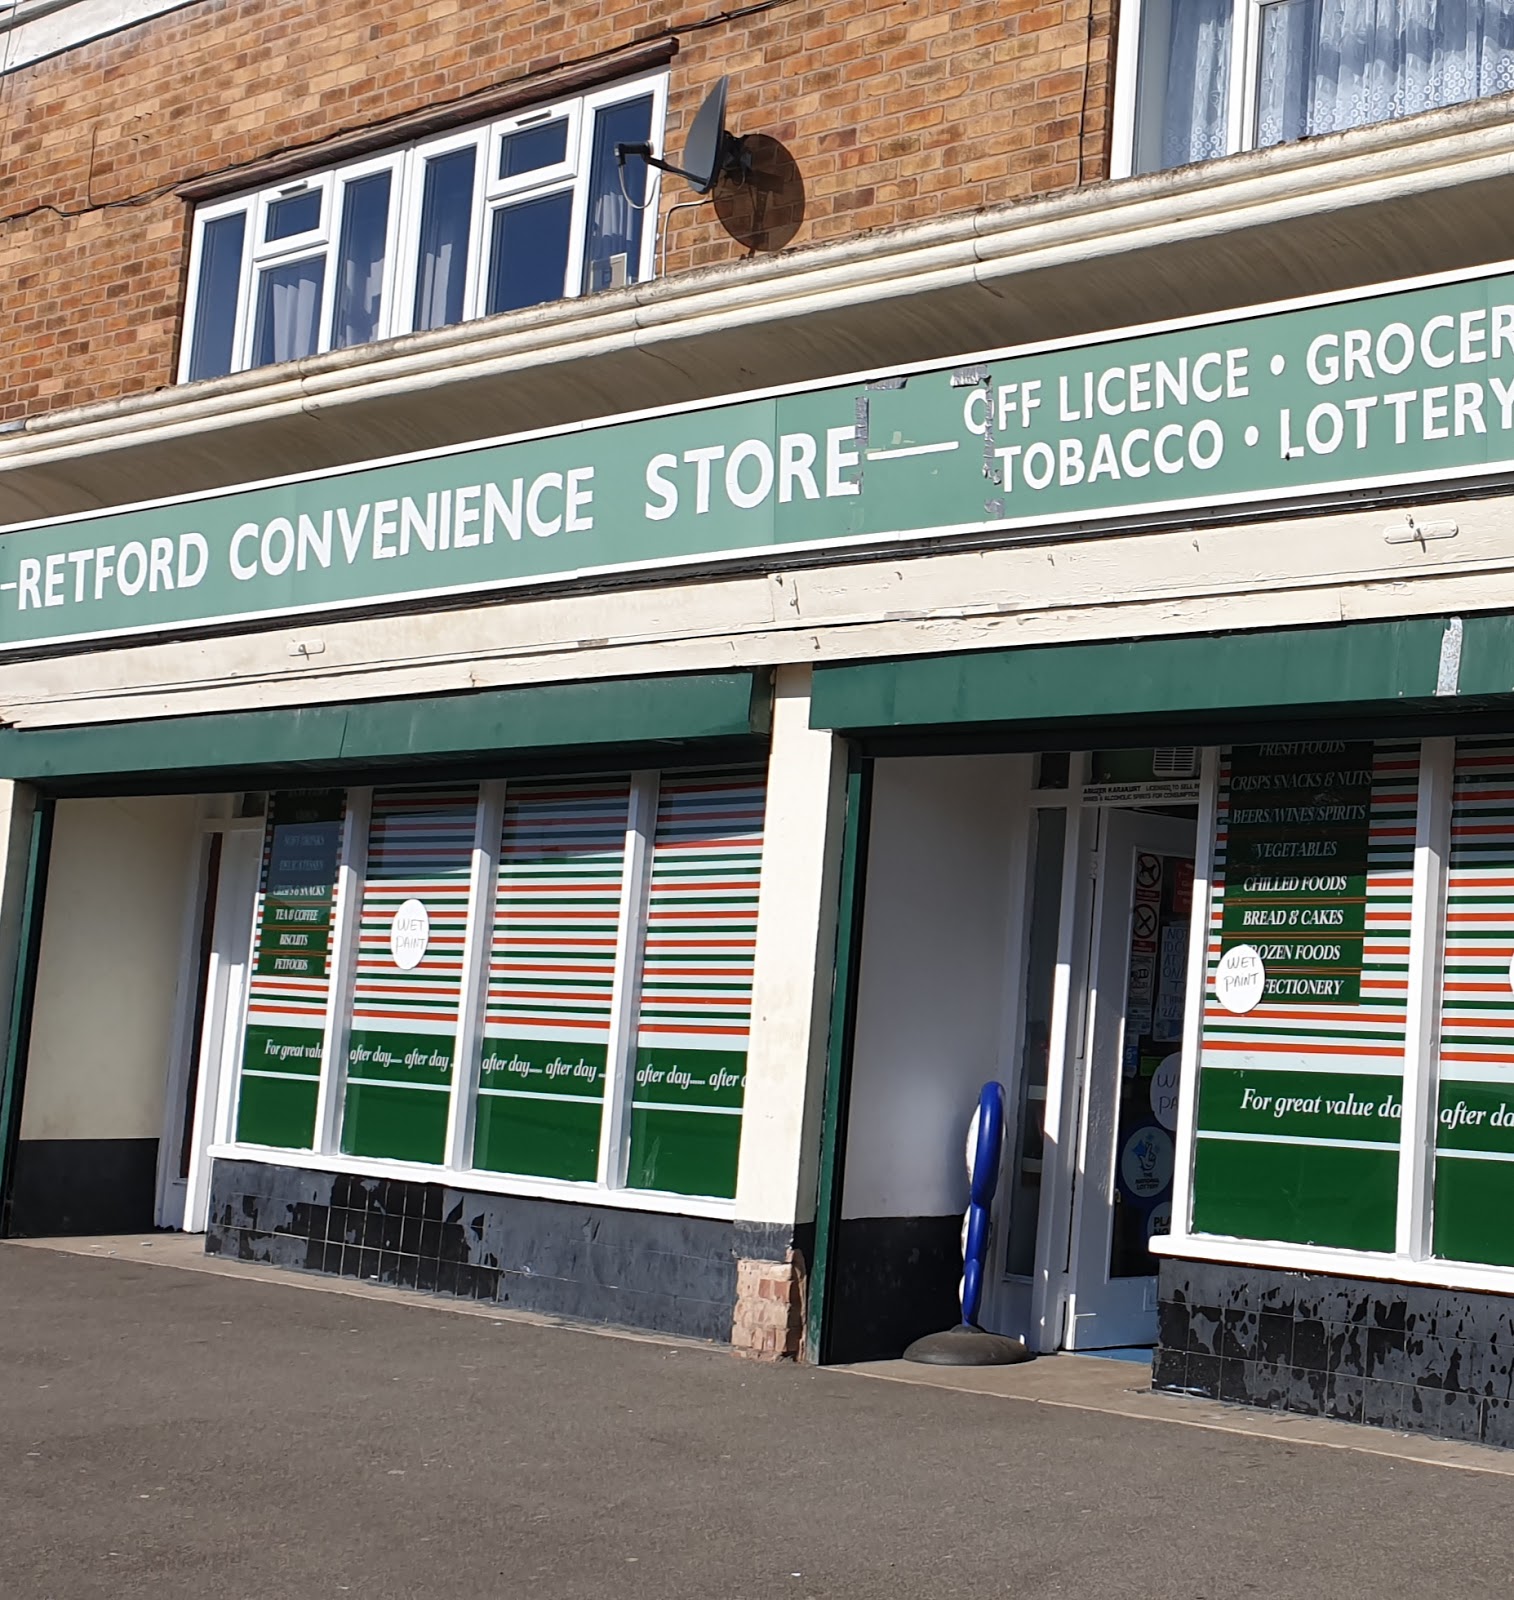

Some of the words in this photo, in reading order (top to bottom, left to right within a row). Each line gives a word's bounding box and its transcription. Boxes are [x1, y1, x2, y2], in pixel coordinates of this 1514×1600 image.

[963, 379, 1042, 435] OFF
[1059, 347, 1250, 422] LICENCE
[1306, 304, 1514, 386] GROCER
[994, 418, 1224, 493] TOBACCO
[1280, 377, 1514, 459] LOTTERY
[18, 532, 209, 611] RETFORD
[229, 466, 595, 580] CONVENIENCE
[644, 424, 862, 521] STORE
[1258, 742, 1299, 757] FRESH
[1299, 740, 1346, 754] FOODS
[1231, 775, 1271, 791] CRISPS
[1273, 772, 1322, 788] SNACKS
[1324, 771, 1336, 786] &
[1336, 769, 1373, 785] NUTS
[1232, 804, 1367, 824] BEERS/WINES/SPIRITS
[1255, 841, 1338, 858] VEGETABLES
[1243, 876, 1300, 892] CHILLED
[1300, 875, 1348, 891] FOODS
[275, 909, 288, 920] TEA
[288, 909, 294, 920] &
[294, 909, 319, 921] COFFEE
[1242, 911, 1287, 926] BREAD
[1288, 910, 1299, 925] &
[1299, 909, 1344, 925] CAKES
[397, 918, 425, 931] WET
[279, 934, 309, 946] BISCUITS
[395, 938, 426, 954] PAINT
[1294, 944, 1341, 960] FOODS
[274, 958, 308, 970] PETFOODS
[1226, 956, 1257, 969] WET
[1224, 972, 1259, 992] PAINT
[1264, 978, 1344, 995] FECTIONERY
[264, 1039, 279, 1055] For
[280, 1044, 305, 1061] great
[349, 1044, 372, 1063] after
[405, 1047, 428, 1070] after
[482, 1052, 508, 1075] after
[545, 1057, 573, 1080] after
[636, 1063, 666, 1087] after
[708, 1067, 740, 1091] after
[1240, 1088, 1273, 1110] For
[1274, 1095, 1322, 1118] great
[1325, 1092, 1374, 1117] value
[1377, 1094, 1402, 1118] da
[1440, 1100, 1487, 1130] after
[1489, 1102, 1514, 1127] da
